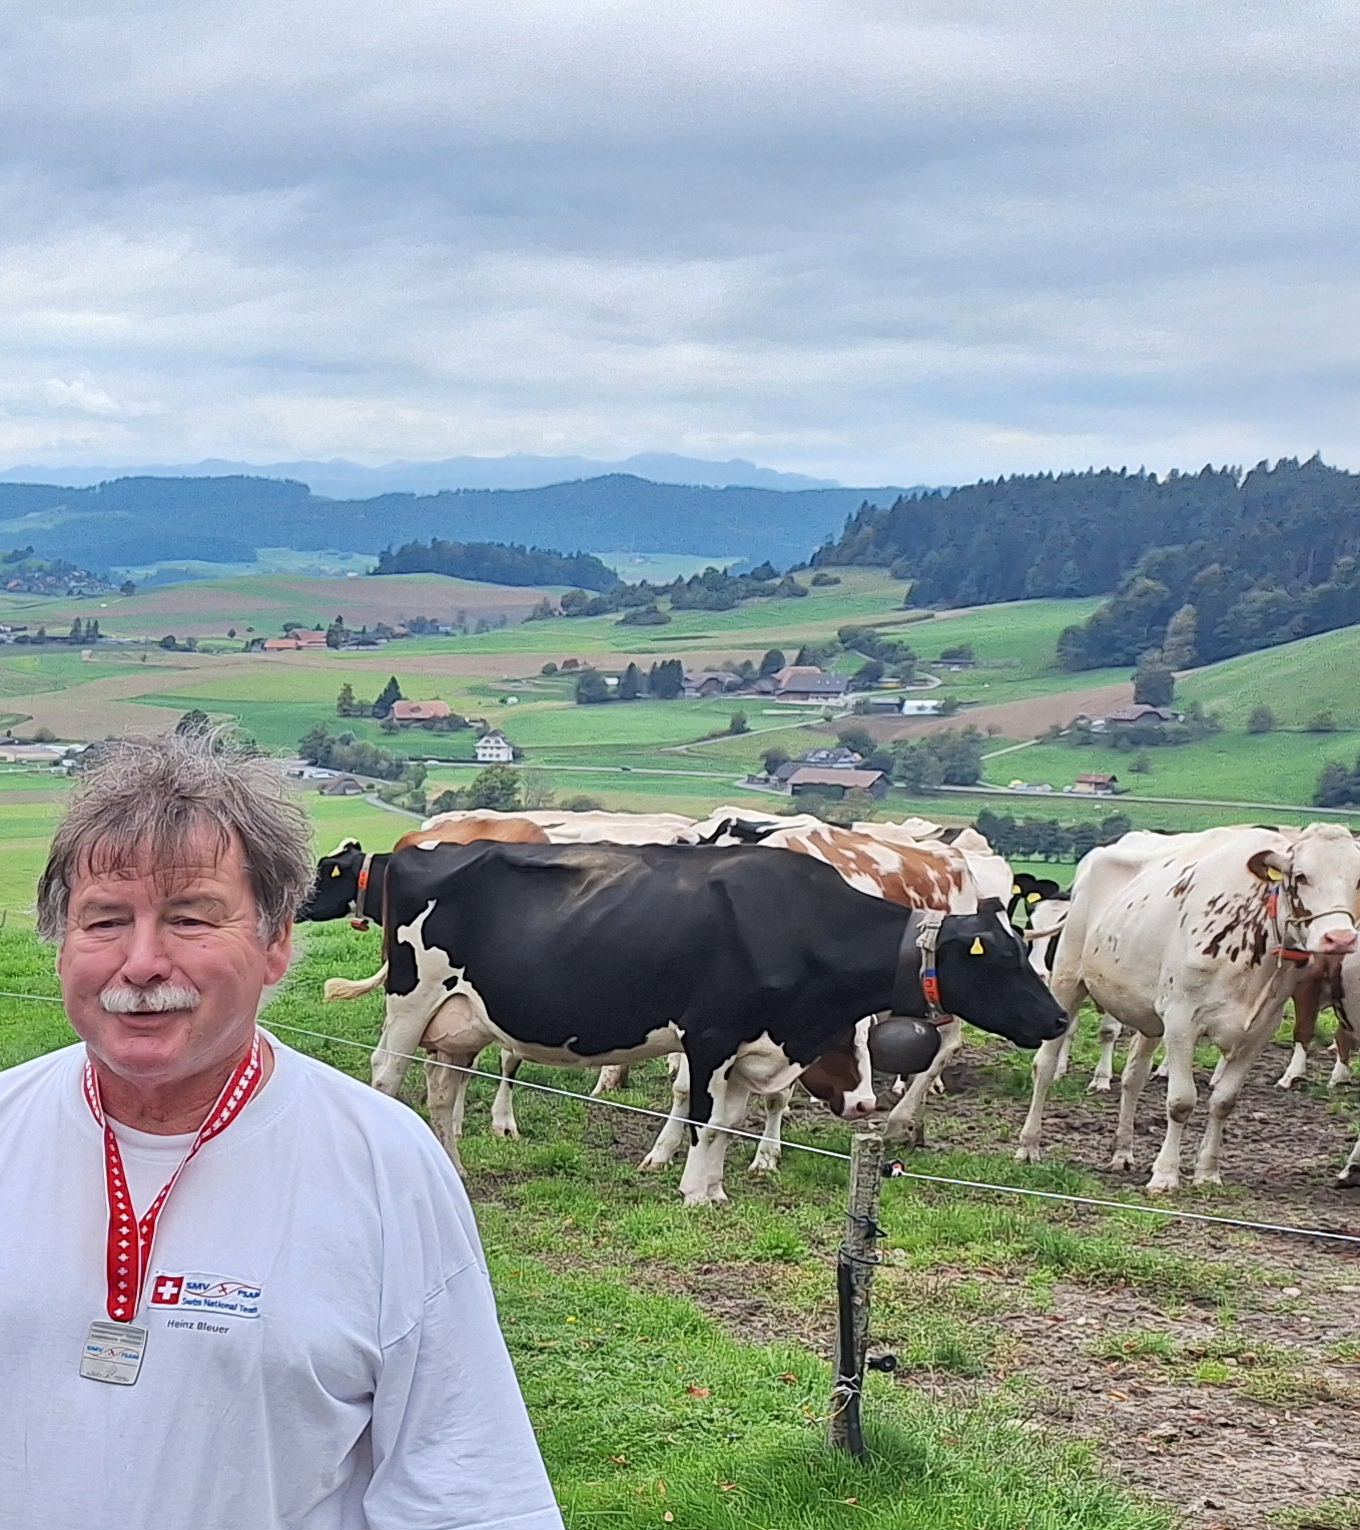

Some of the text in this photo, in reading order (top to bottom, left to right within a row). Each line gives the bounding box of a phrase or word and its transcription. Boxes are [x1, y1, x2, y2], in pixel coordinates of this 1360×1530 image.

[186, 1282, 210, 1290] SMV
[204, 1299, 238, 1310] National
[167, 1319, 194, 1329] Heinz
